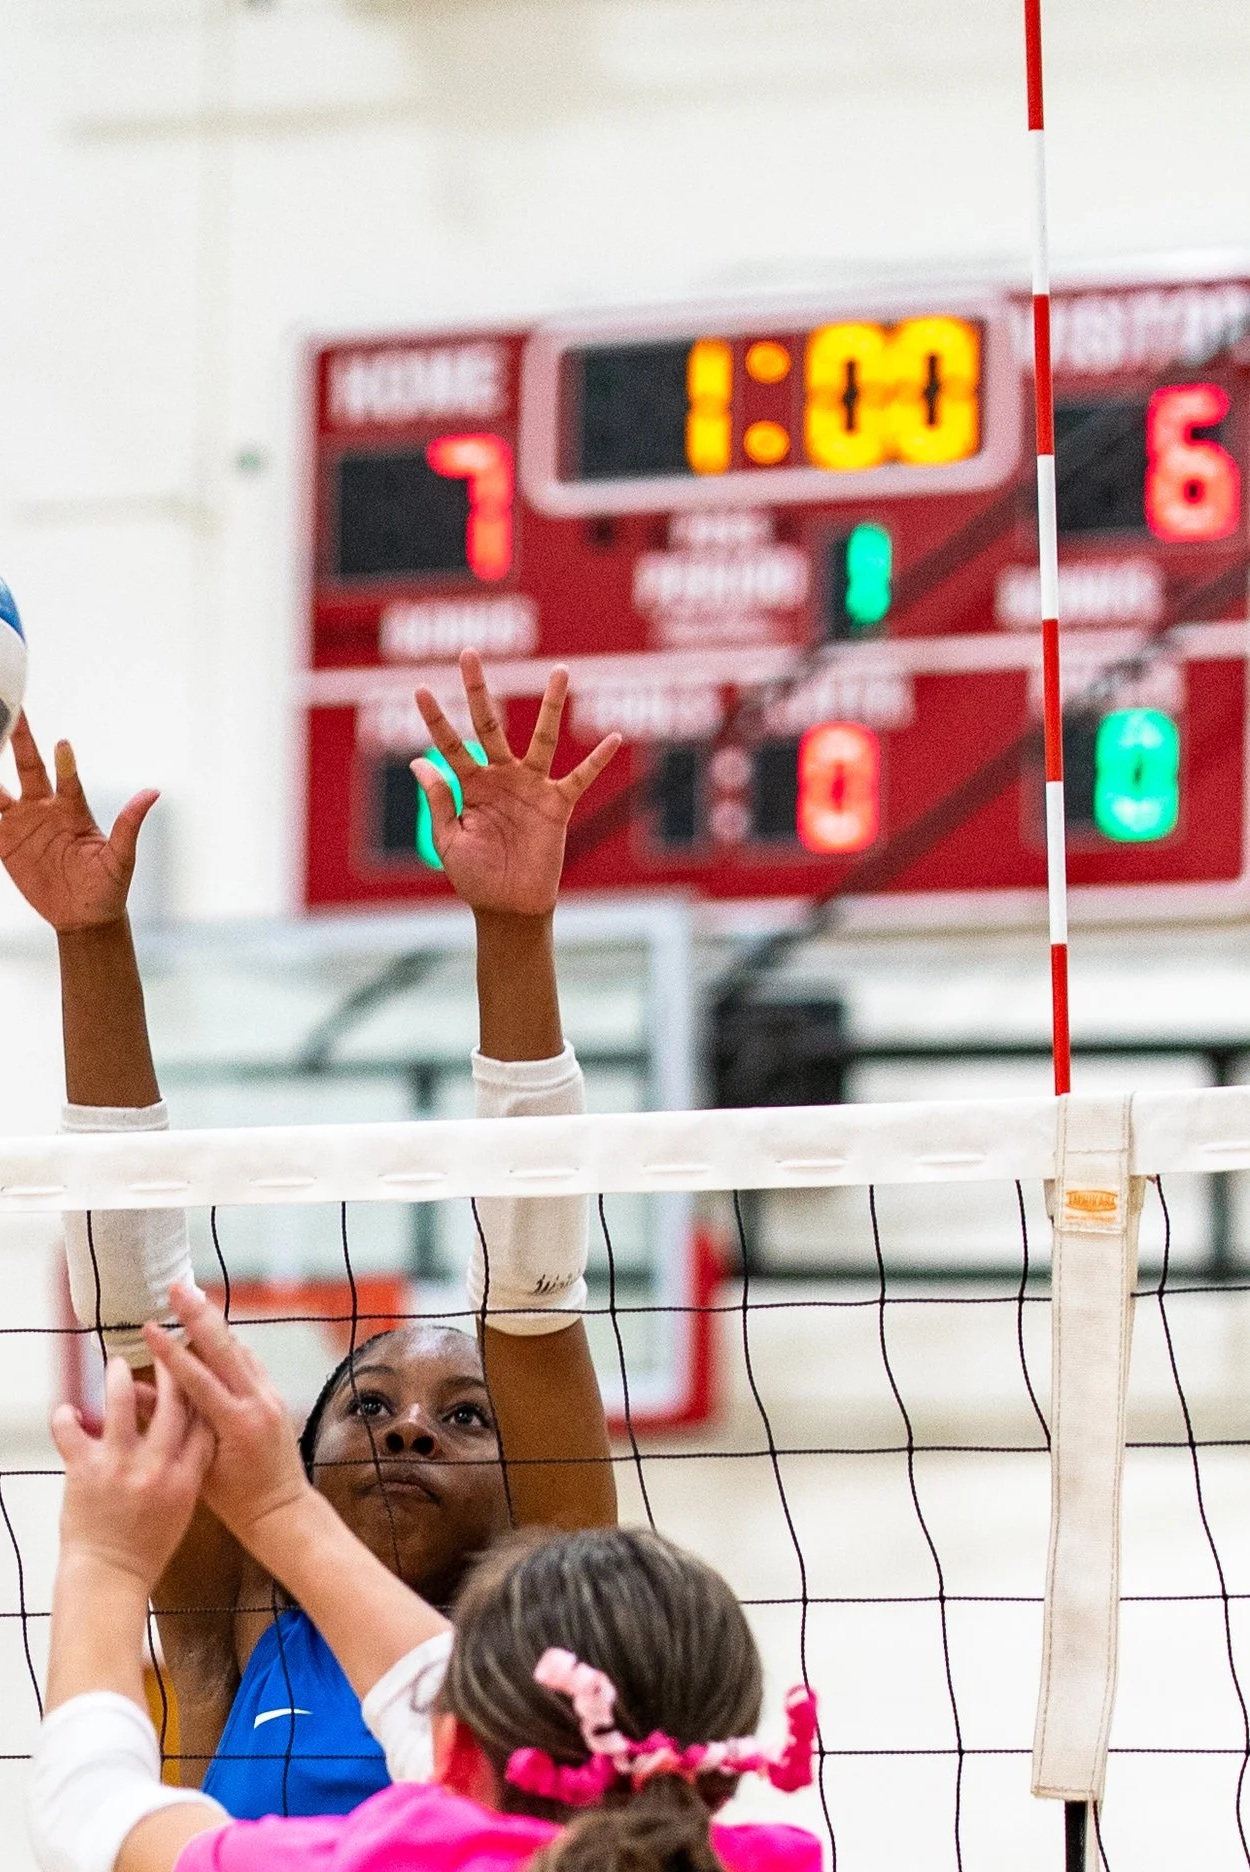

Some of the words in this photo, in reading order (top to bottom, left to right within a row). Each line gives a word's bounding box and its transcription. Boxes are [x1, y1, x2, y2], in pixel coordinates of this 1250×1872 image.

[688, 314, 980, 474] 1:00
[1145, 384, 1240, 542] 6
[427, 433, 514, 581] 7
